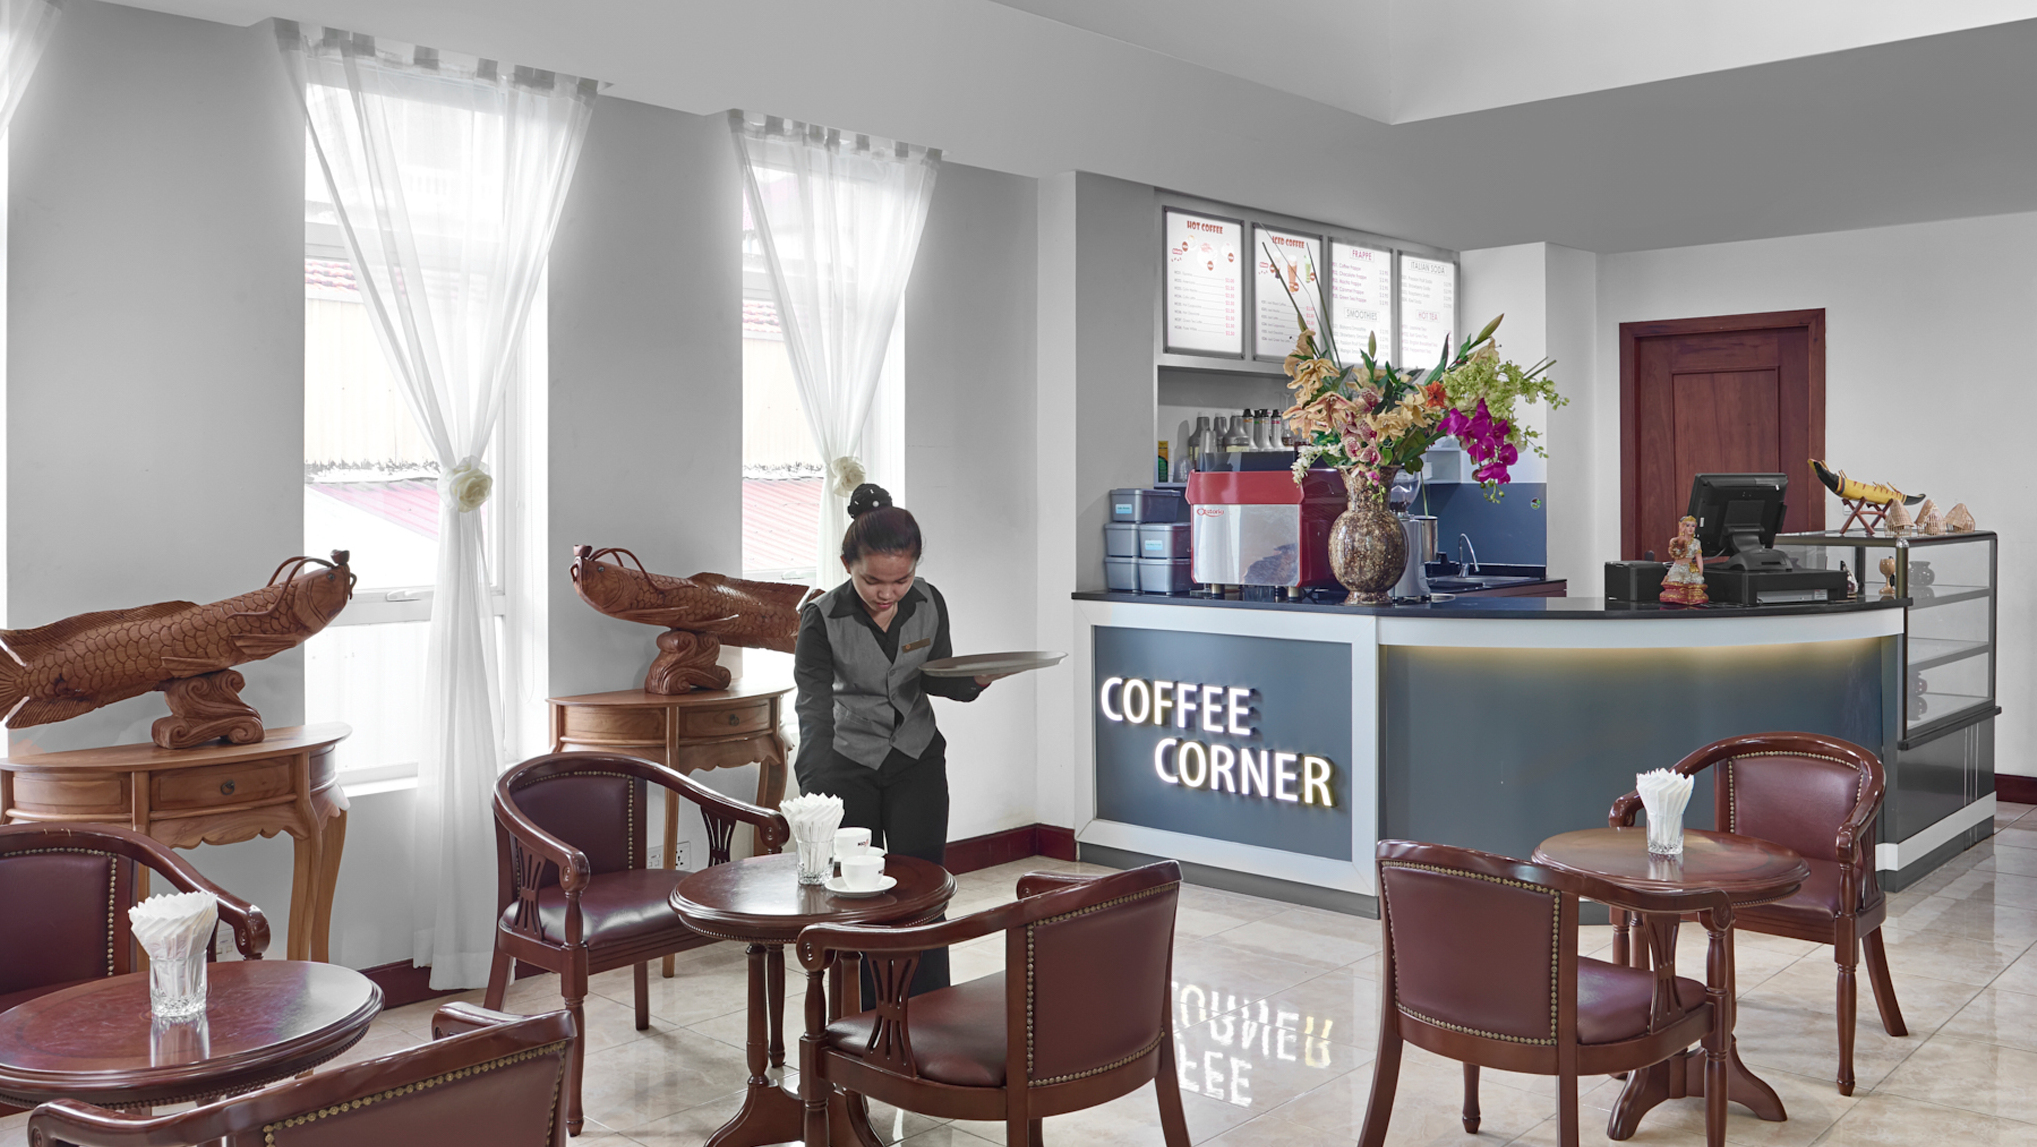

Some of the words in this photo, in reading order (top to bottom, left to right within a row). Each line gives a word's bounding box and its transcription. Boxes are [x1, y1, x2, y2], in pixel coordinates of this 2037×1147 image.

[1187, 220, 1201, 230] HOT
[1201, 223, 1223, 234] COFFEE
[1272, 236, 1285, 245] ICED
[1285, 238, 1305, 249] COFFEE
[1352, 249, 1372, 261] FRAPPE
[1410, 261, 1430, 272] ITALIAN
[1430, 264, 1445, 274] SODA
[1346, 308, 1377, 321] SMOOTHIES
[1418, 311, 1428, 320] HOT
[1429, 312, 1438, 321] TEA
[1101, 677, 1251, 736] COFFEE
[1154, 738, 1336, 807] CORNER
